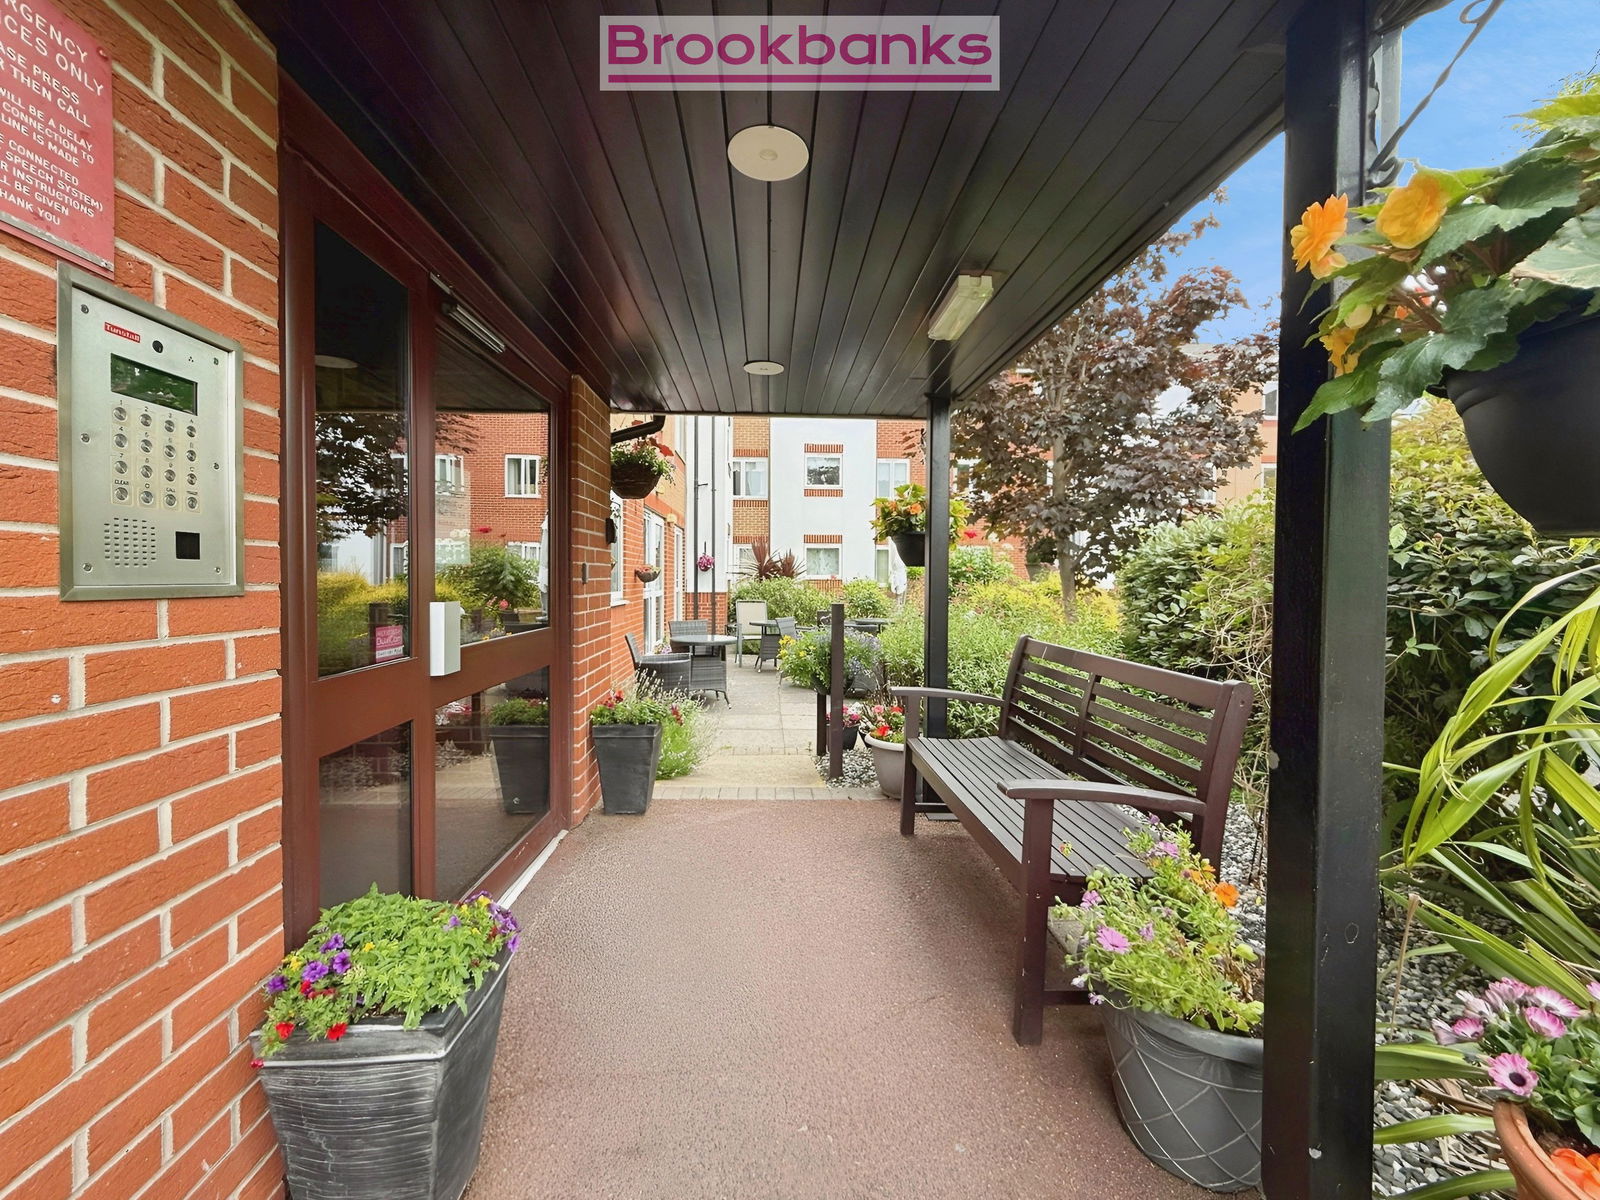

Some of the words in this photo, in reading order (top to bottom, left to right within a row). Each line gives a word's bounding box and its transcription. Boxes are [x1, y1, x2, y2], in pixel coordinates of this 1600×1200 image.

[10, 64, 52, 101] THEN
[57, 98, 91, 128] CALL
[33, 64, 80, 105] PRESS
[55, 52, 103, 96] ONLY
[3, 101, 78, 154] CONNECTION
[81, 150, 94, 164] TO
[29, 104, 45, 121] BE
[48, 118, 56, 128] A
[60, 123, 92, 151] DELAY
[33, 131, 45, 145] IS
[48, 141, 79, 168] MADE
[6, 151, 54, 183] SPEECH
[57, 180, 103, 212] SYSTEM)
[9, 140, 79, 186] CONNECTED
[13, 167, 95, 218] INSTRUCTIONS
[15, 180, 31, 196] BE
[35, 192, 69, 216] GIVEN
[37, 207, 60, 225] YOU
